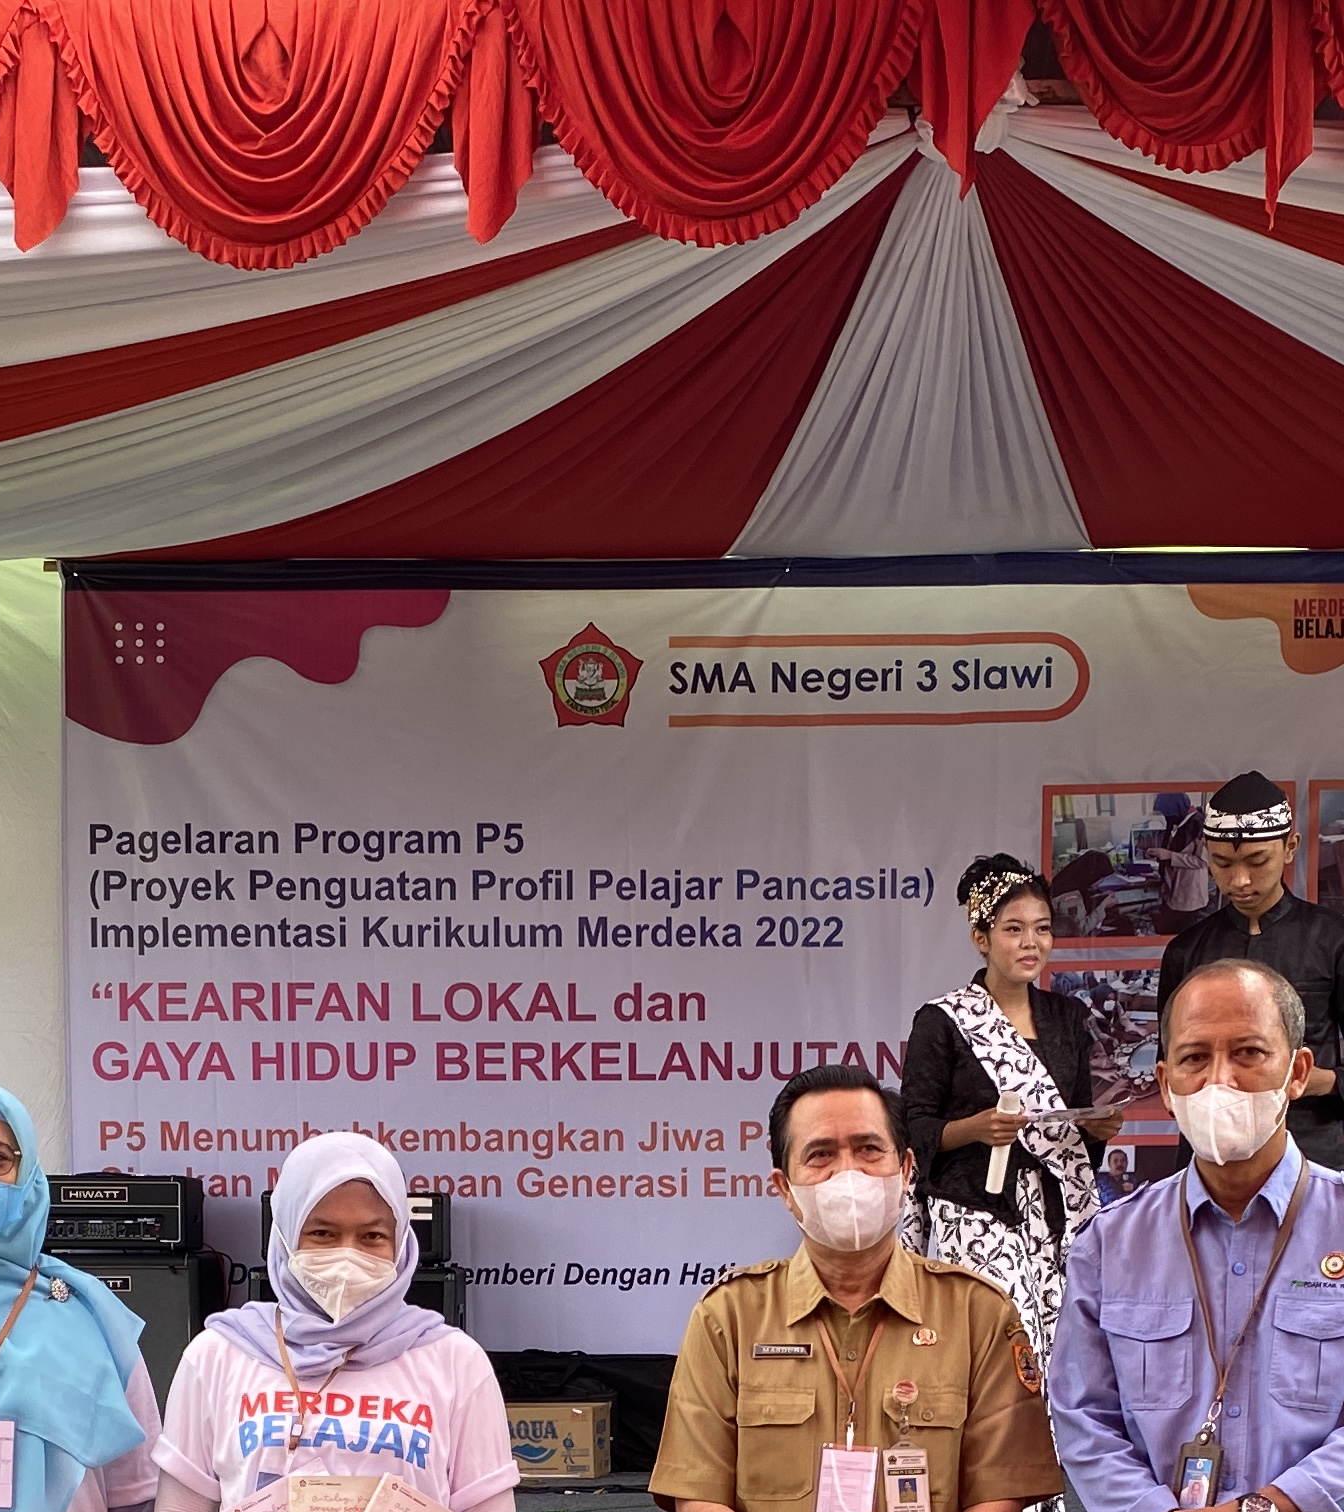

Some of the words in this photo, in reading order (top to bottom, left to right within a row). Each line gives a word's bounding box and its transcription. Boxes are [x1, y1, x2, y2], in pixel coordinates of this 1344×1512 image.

[669, 662, 757, 696] SMA
[770, 659, 904, 703] Negeri
[917, 660, 939, 693] 3
[951, 656, 1054, 693] Slawi
[88, 823, 280, 861] Pagelaran
[294, 823, 462, 863] Program
[476, 823, 525, 854] P5
[89, 869, 235, 910] (Proyek
[249, 871, 458, 910] Penguatan
[471, 869, 574, 901] Profil
[588, 868, 723, 909] Pelajar
[736, 867, 936, 906] Pancasila)
[90, 917, 348, 957] Implementasi
[362, 917, 563, 948] Kurikulum
[577, 916, 743, 948] Merdeka
[755, 917, 845, 948] 2022
[412, 982, 598, 1022] LOKAL
[613, 982, 707, 1022] dan
[91, 1042, 236, 1082] GAYA
[251, 1042, 417, 1082] HIDUP
[436, 1041, 908, 1082] BERKELANJUTAN
[100, 1121, 147, 1152] P5
[638, 1121, 725, 1152] Jiwa
[69, 1190, 119, 1199] HIWATT
[513, 1166, 688, 1199] Generasi
[457, 1263, 556, 1286] emberi
[563, 1263, 670, 1292] Dengan
[239, 1391, 434, 1434] MERDEKA
